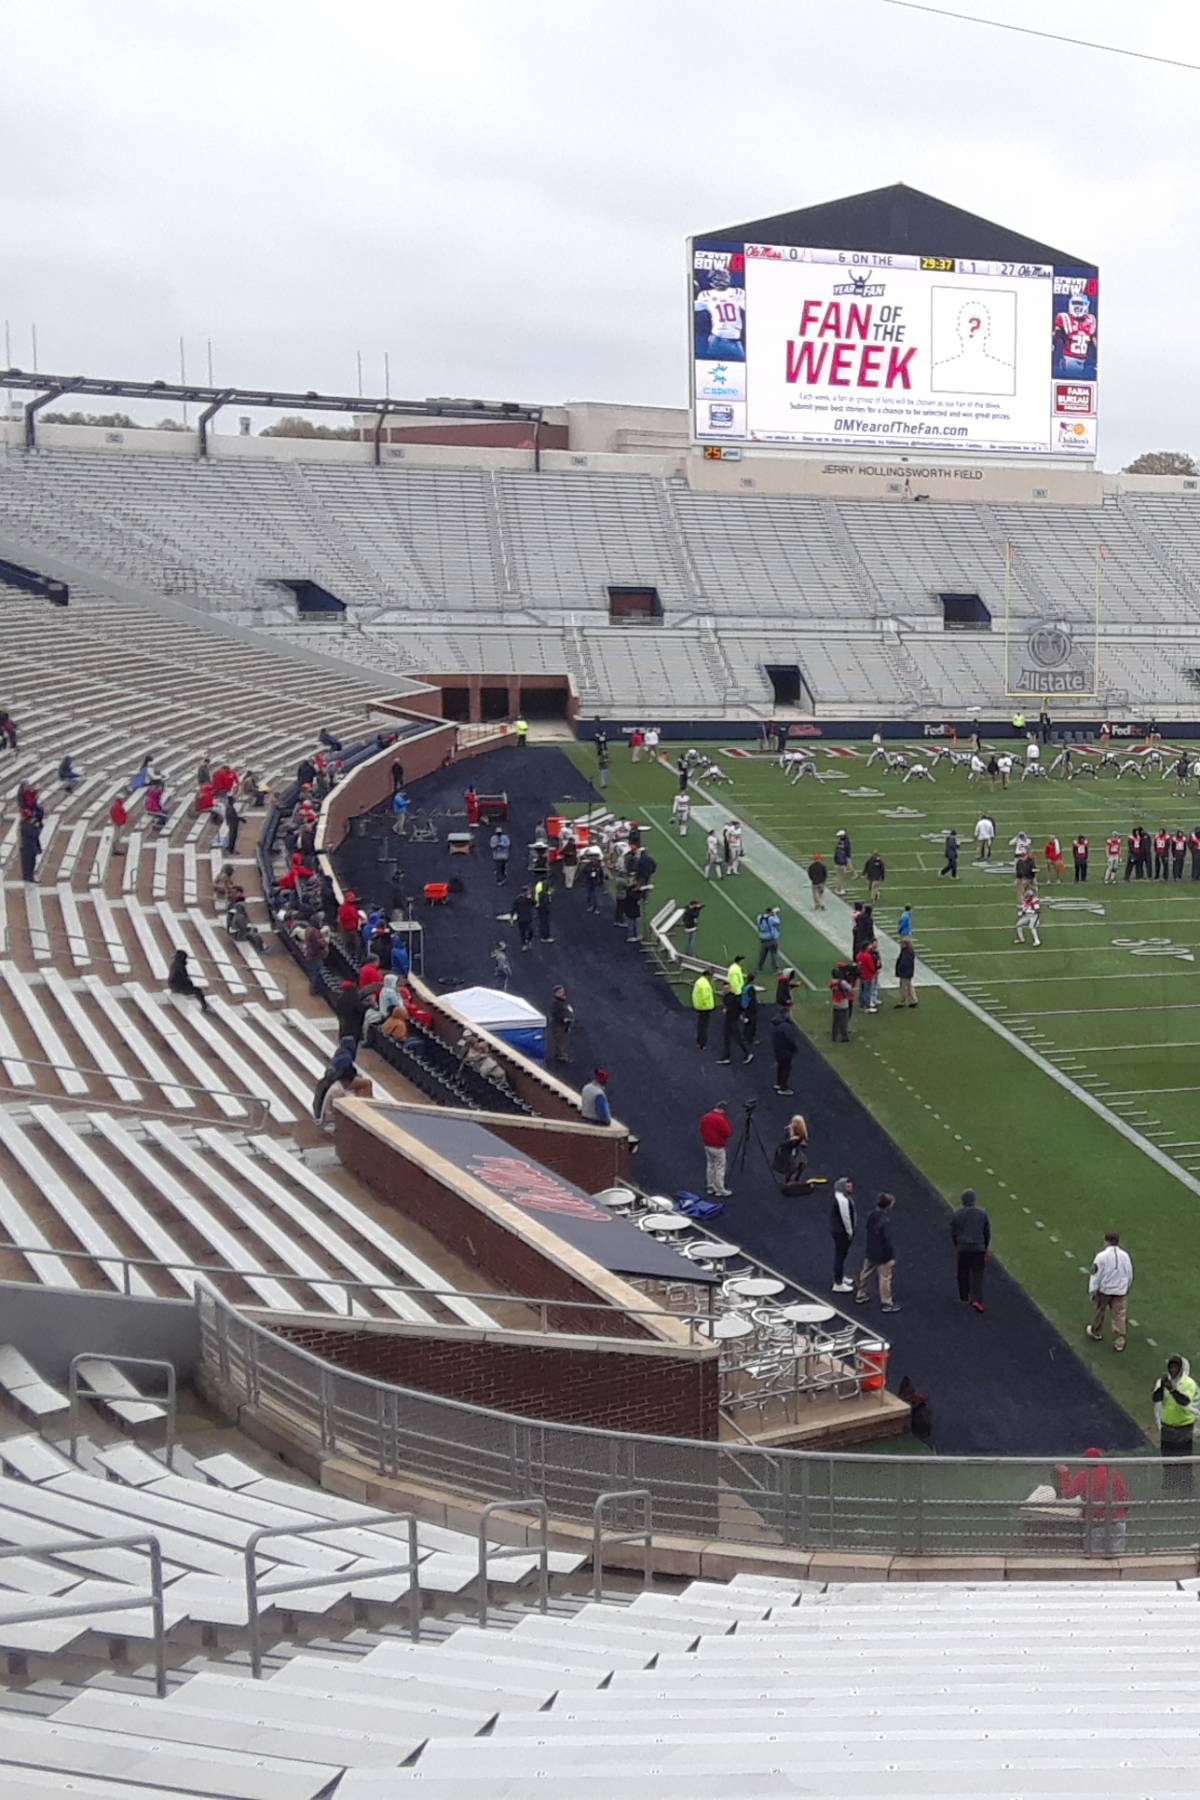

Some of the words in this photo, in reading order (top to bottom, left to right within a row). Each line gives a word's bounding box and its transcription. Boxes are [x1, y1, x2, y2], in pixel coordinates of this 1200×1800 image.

[746, 246, 761, 258] Ole
[760, 246, 784, 259] Miss
[789, 248, 797, 259] 0
[852, 253, 868, 264] ON
[872, 255, 893, 266] THE
[921, 257, 953, 270] 29:37
[1001, 264, 1015, 276] 27
[834, 285, 855, 295] YEAR
[863, 285, 885, 297] FAN
[715, 303, 737, 323] 10
[799, 300, 873, 340] FAN
[879, 304, 903, 324] OF
[873, 323, 906, 342] THE
[968, 317, 981, 339] ?
[786, 340, 918, 389] WEEK
[789, 402, 813, 410] Submit
[830, 404, 844, 412] best
[949, 410, 960, 418] and
[834, 418, 969, 438] OMYearofTheFan.com
[822, 464, 855, 475] JERRY
[858, 466, 952, 479] HOLLINGSWORTH
[954, 469, 983, 480] FIELD
[1018, 672, 1083, 691] Allstate
